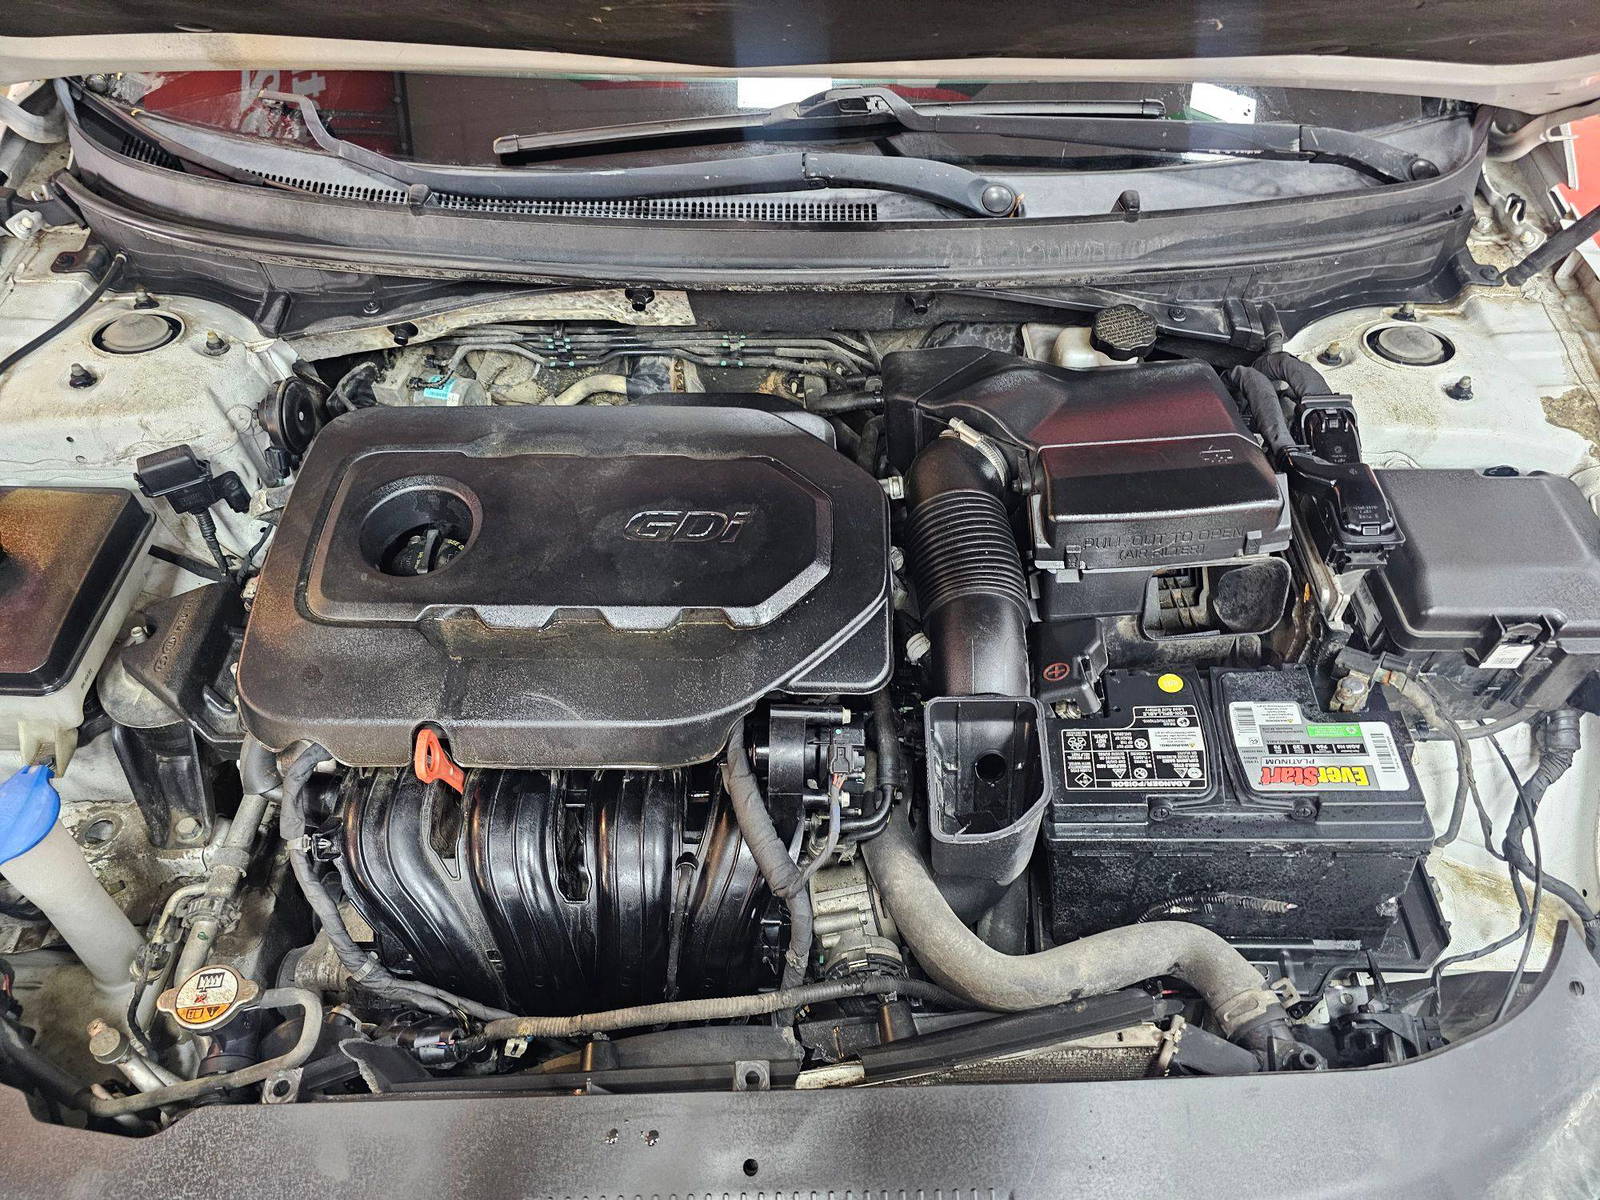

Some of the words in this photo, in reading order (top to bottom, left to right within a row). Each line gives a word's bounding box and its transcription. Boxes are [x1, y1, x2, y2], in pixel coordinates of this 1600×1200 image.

[622, 511, 752, 543] GDi
[1084, 537, 1125, 549] PULL
[1132, 534, 1165, 546] OUT
[1171, 531, 1194, 543] TO
[1198, 528, 1244, 541] OPEN
[1118, 548, 1148, 560] (AIR
[1151, 544, 1205, 559] FILTER)
[1260, 766, 1370, 787] EverStart
